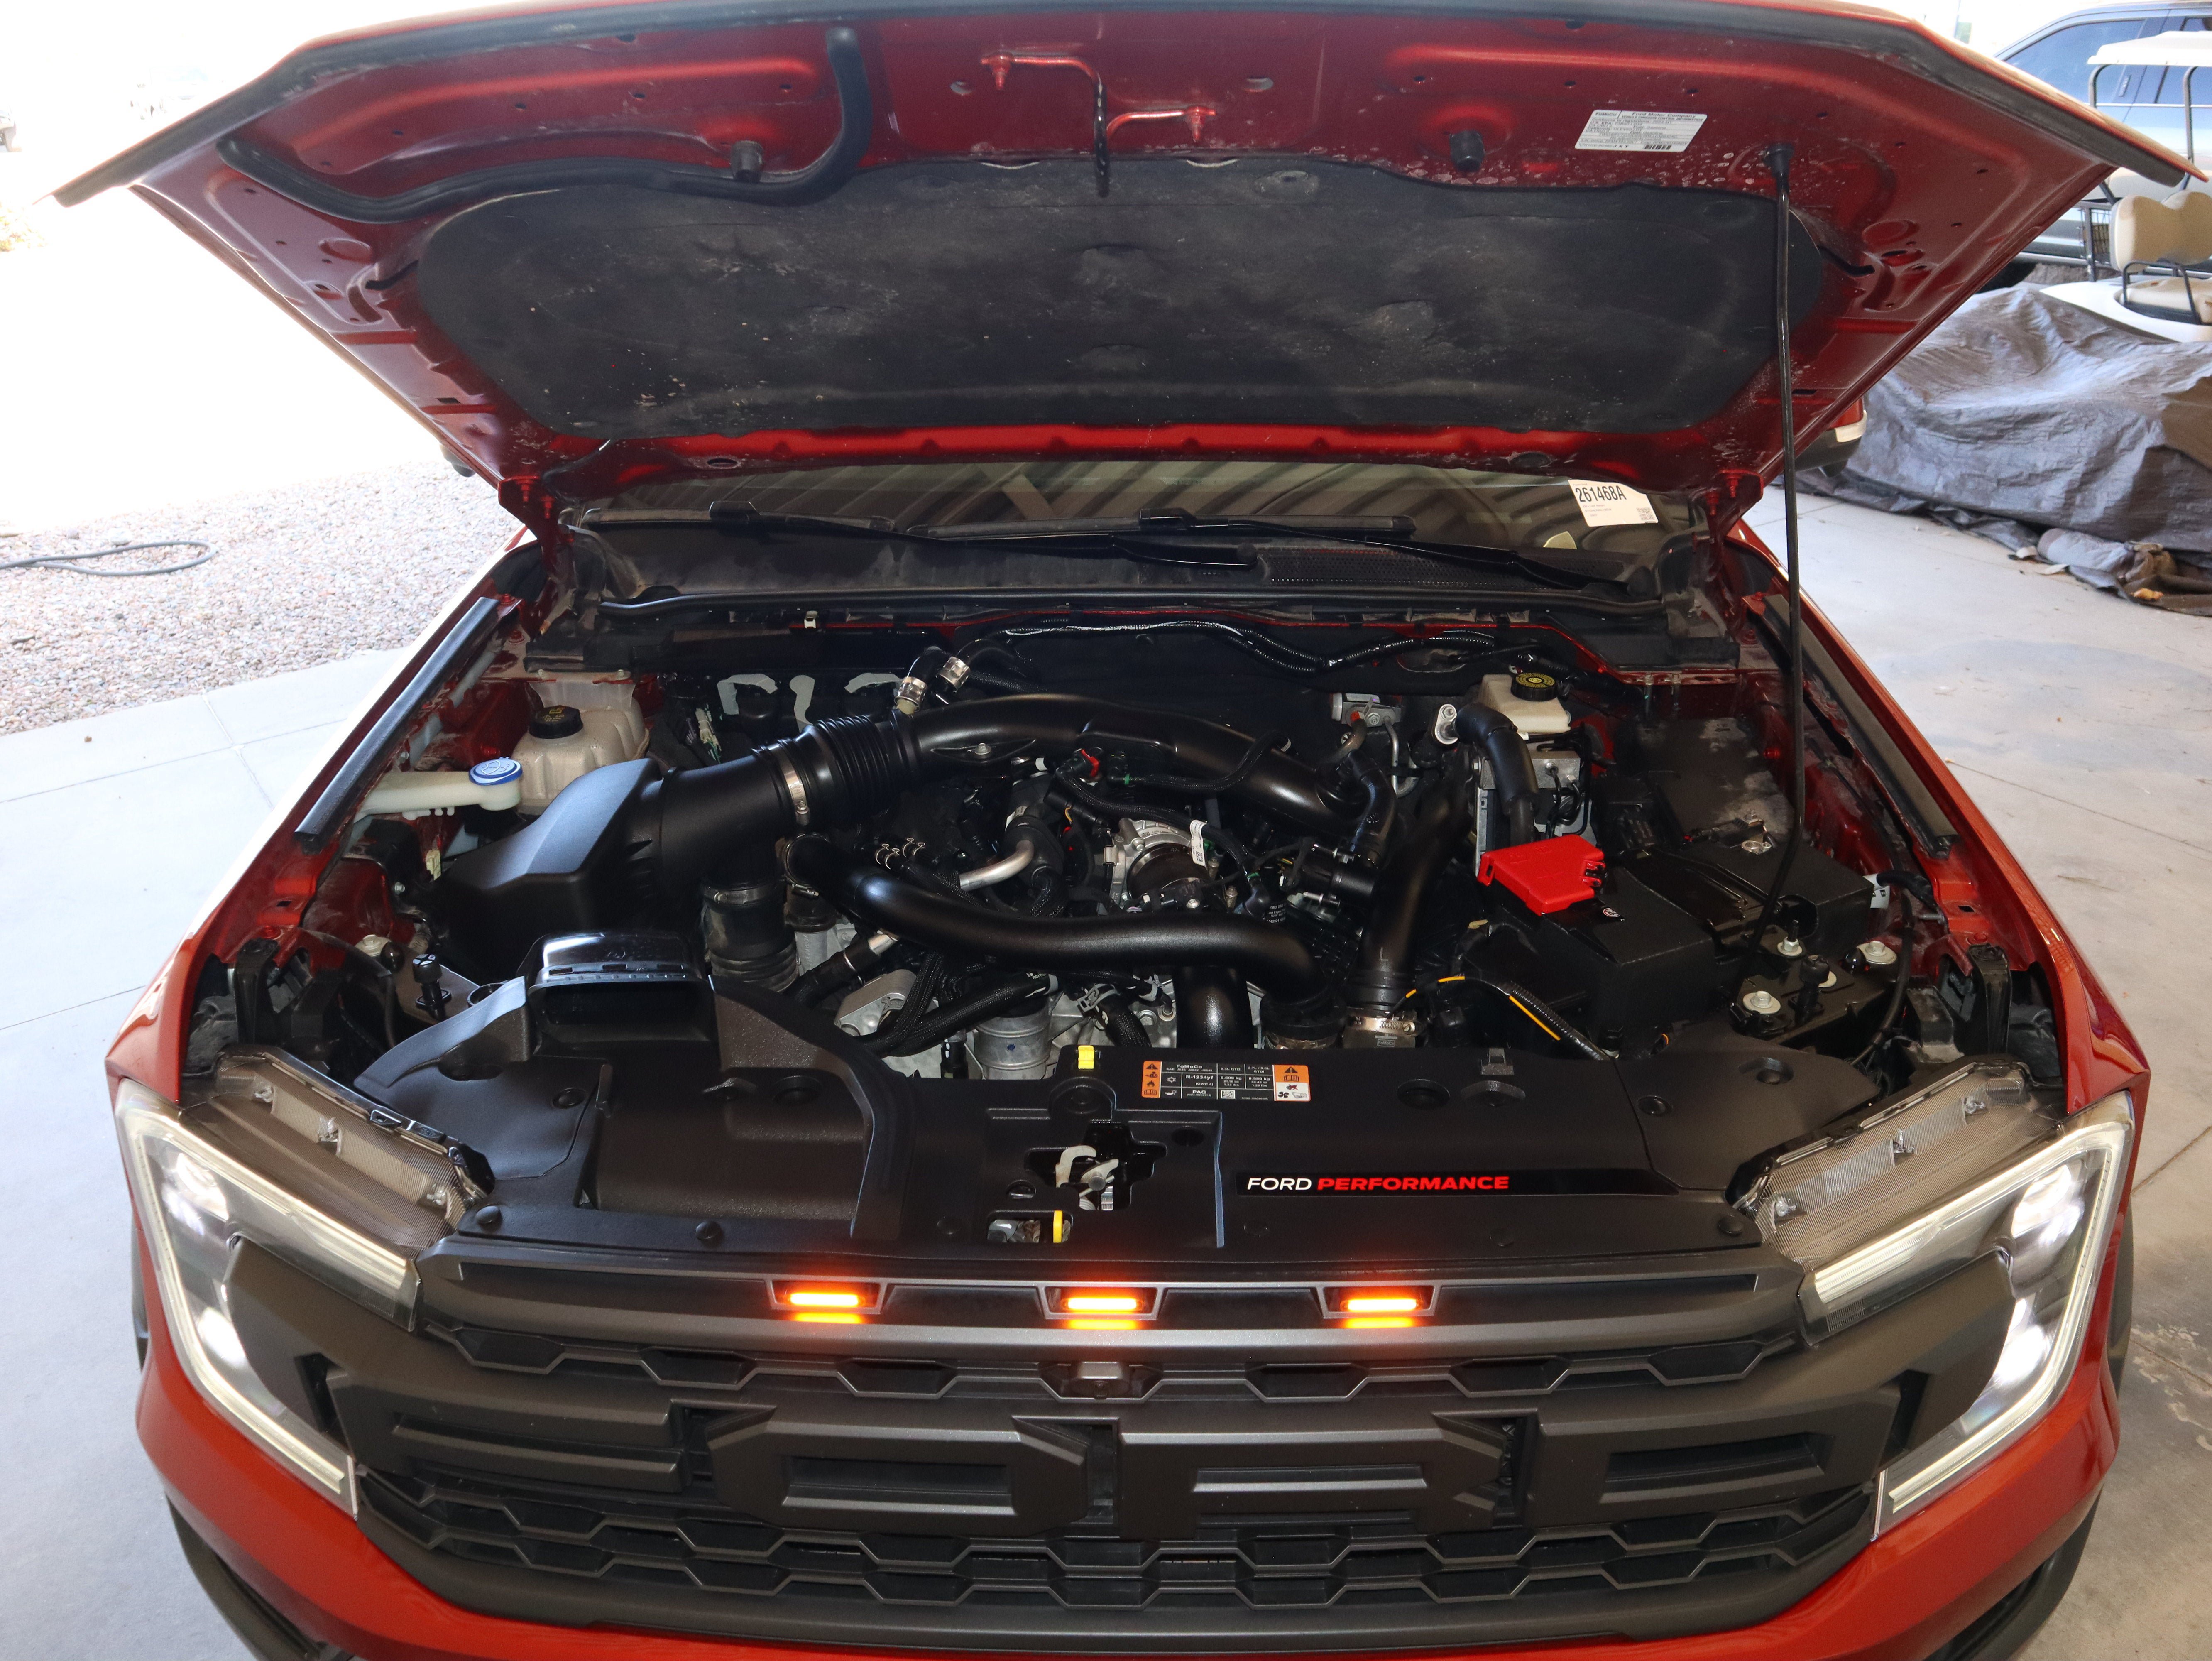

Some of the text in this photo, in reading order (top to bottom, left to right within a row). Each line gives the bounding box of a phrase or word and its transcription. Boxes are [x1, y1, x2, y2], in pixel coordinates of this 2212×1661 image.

[1575, 485, 1627, 502] 261468A
[1379, 947, 1389, 961] L
[1247, 1176, 1510, 1191] FORD PERFORMANCE
